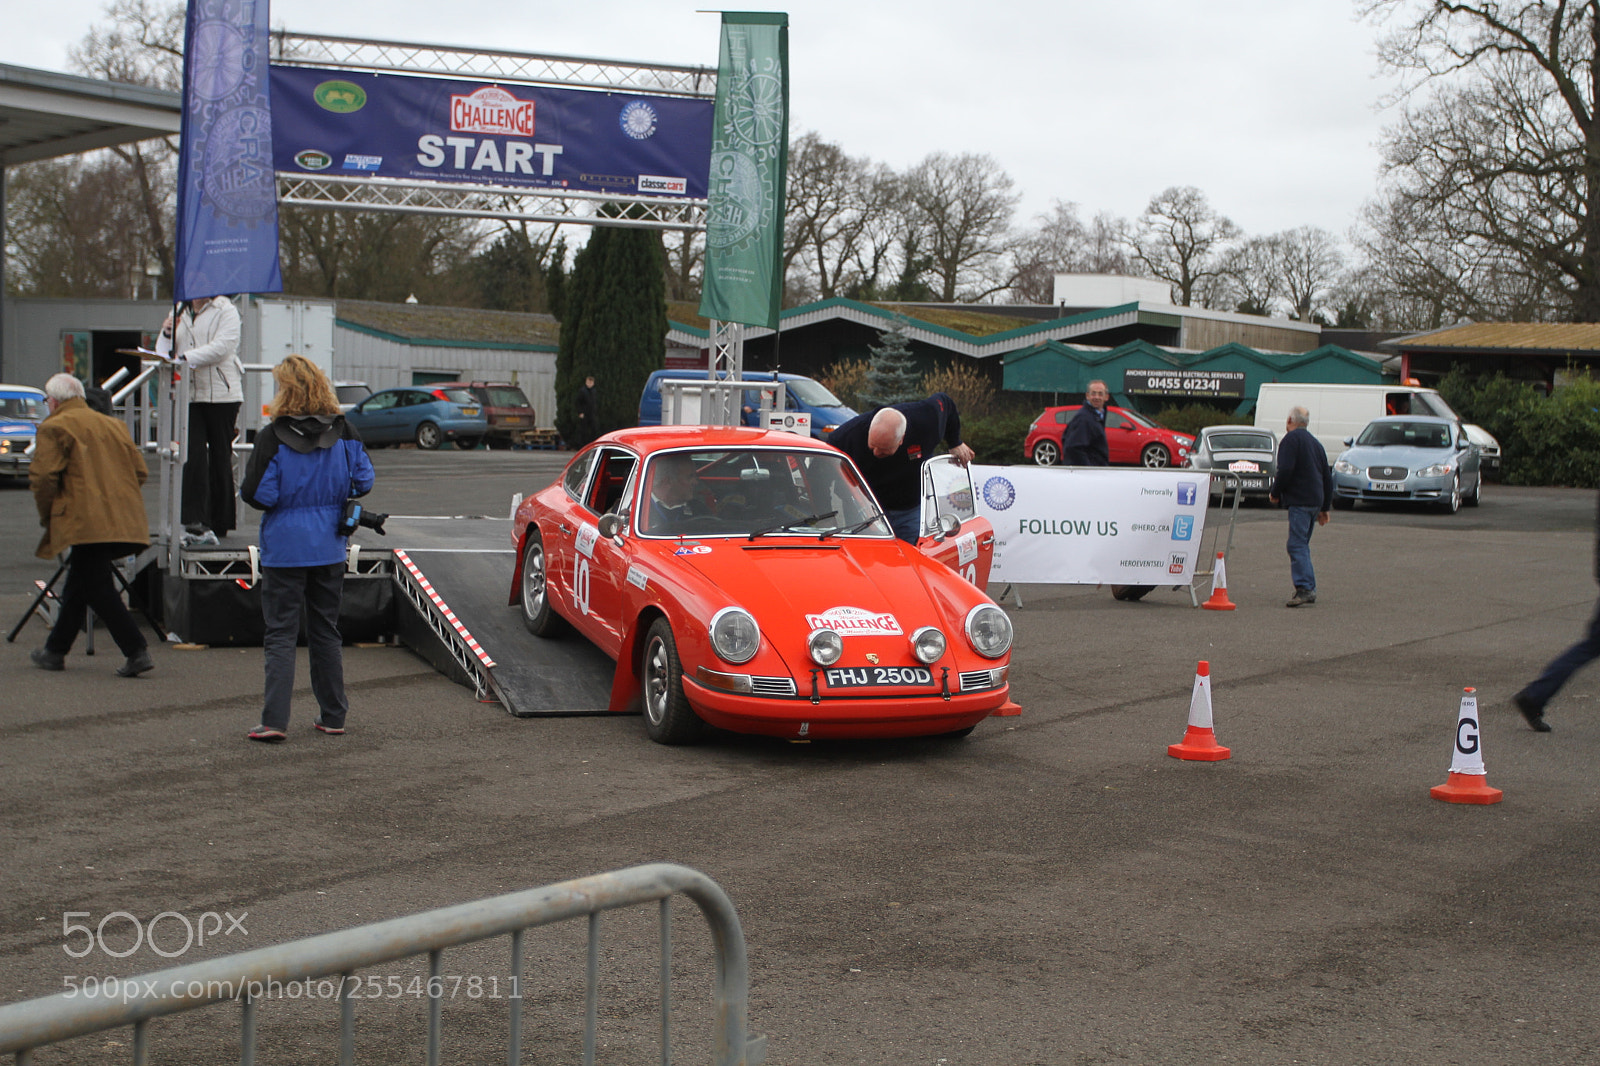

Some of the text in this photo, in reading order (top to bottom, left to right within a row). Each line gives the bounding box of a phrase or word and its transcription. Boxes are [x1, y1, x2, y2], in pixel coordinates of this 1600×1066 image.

[454, 99, 532, 134] CHALLENGE
[240, 111, 262, 184] CRA
[417, 134, 564, 175] START
[641, 178, 667, 189] classic
[667, 181, 684, 191] cars
[1147, 370, 1177, 378] EXHIBITIONS
[1183, 371, 1210, 379] ELECTRICAL
[1234, 372, 1244, 380] LTD
[1148, 377, 1220, 391] 01455 612341
[1140, 487, 1173, 498] /herorally
[1019, 518, 1119, 537] FOLLOW US
[1131, 523, 1170, 534] @HERO_CRA
[1119, 559, 1164, 568] HEROEVENTSEU
[1172, 554, 1185, 564] You
[1170, 564, 1183, 573] Tube
[573, 552, 590, 615] 10
[811, 616, 899, 631] CHALLENGE
[826, 668, 931, 685] FHJ 250D
[1456, 717, 1479, 755] G
